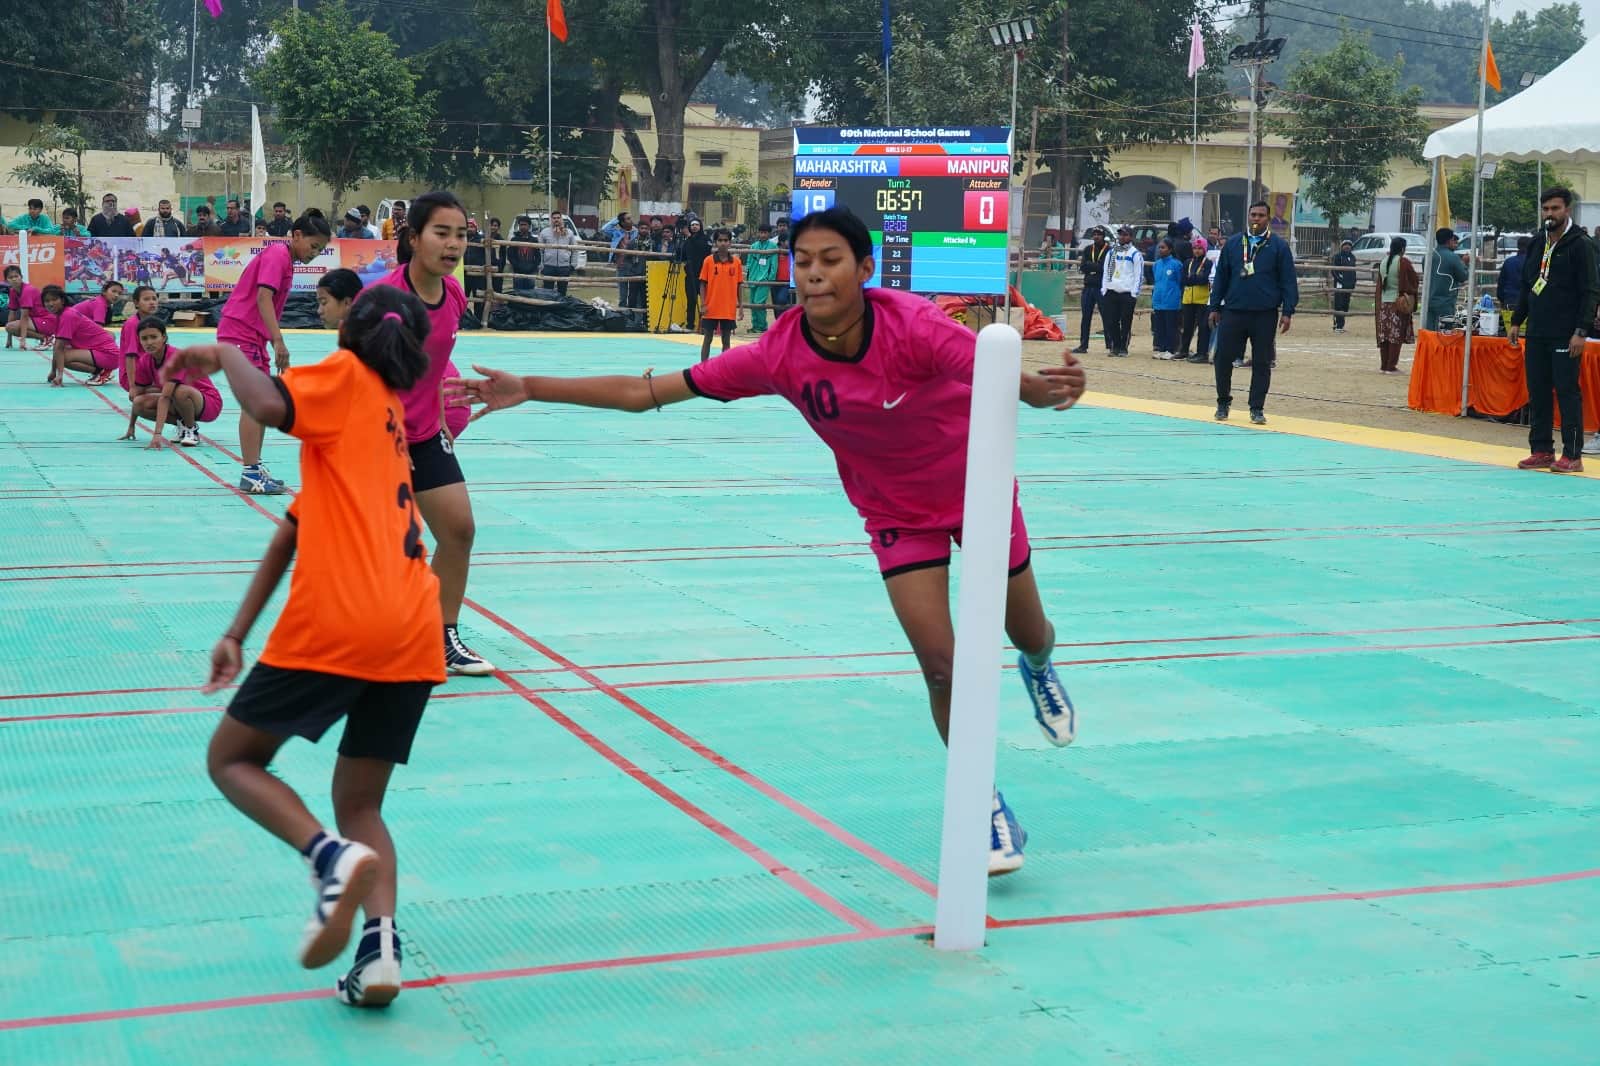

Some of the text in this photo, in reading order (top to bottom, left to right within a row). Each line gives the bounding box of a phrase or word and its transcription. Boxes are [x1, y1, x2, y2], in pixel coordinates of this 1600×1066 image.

[864, 129, 902, 137] National
[904, 128, 936, 137] School
[937, 128, 971, 137] Games
[795, 159, 887, 173] MAHARASHTRA
[947, 159, 1009, 174] MANIPUR
[800, 179, 832, 189] Defender
[888, 179, 911, 188] Turn 2
[969, 179, 1002, 188] Attacker
[876, 190, 922, 211] 06:57
[979, 195, 994, 225] 0
[884, 220, 907, 232] 02:03
[885, 235, 909, 243] Per Time
[943, 236, 976, 245] Attacked By
[802, 379, 840, 422] 10
